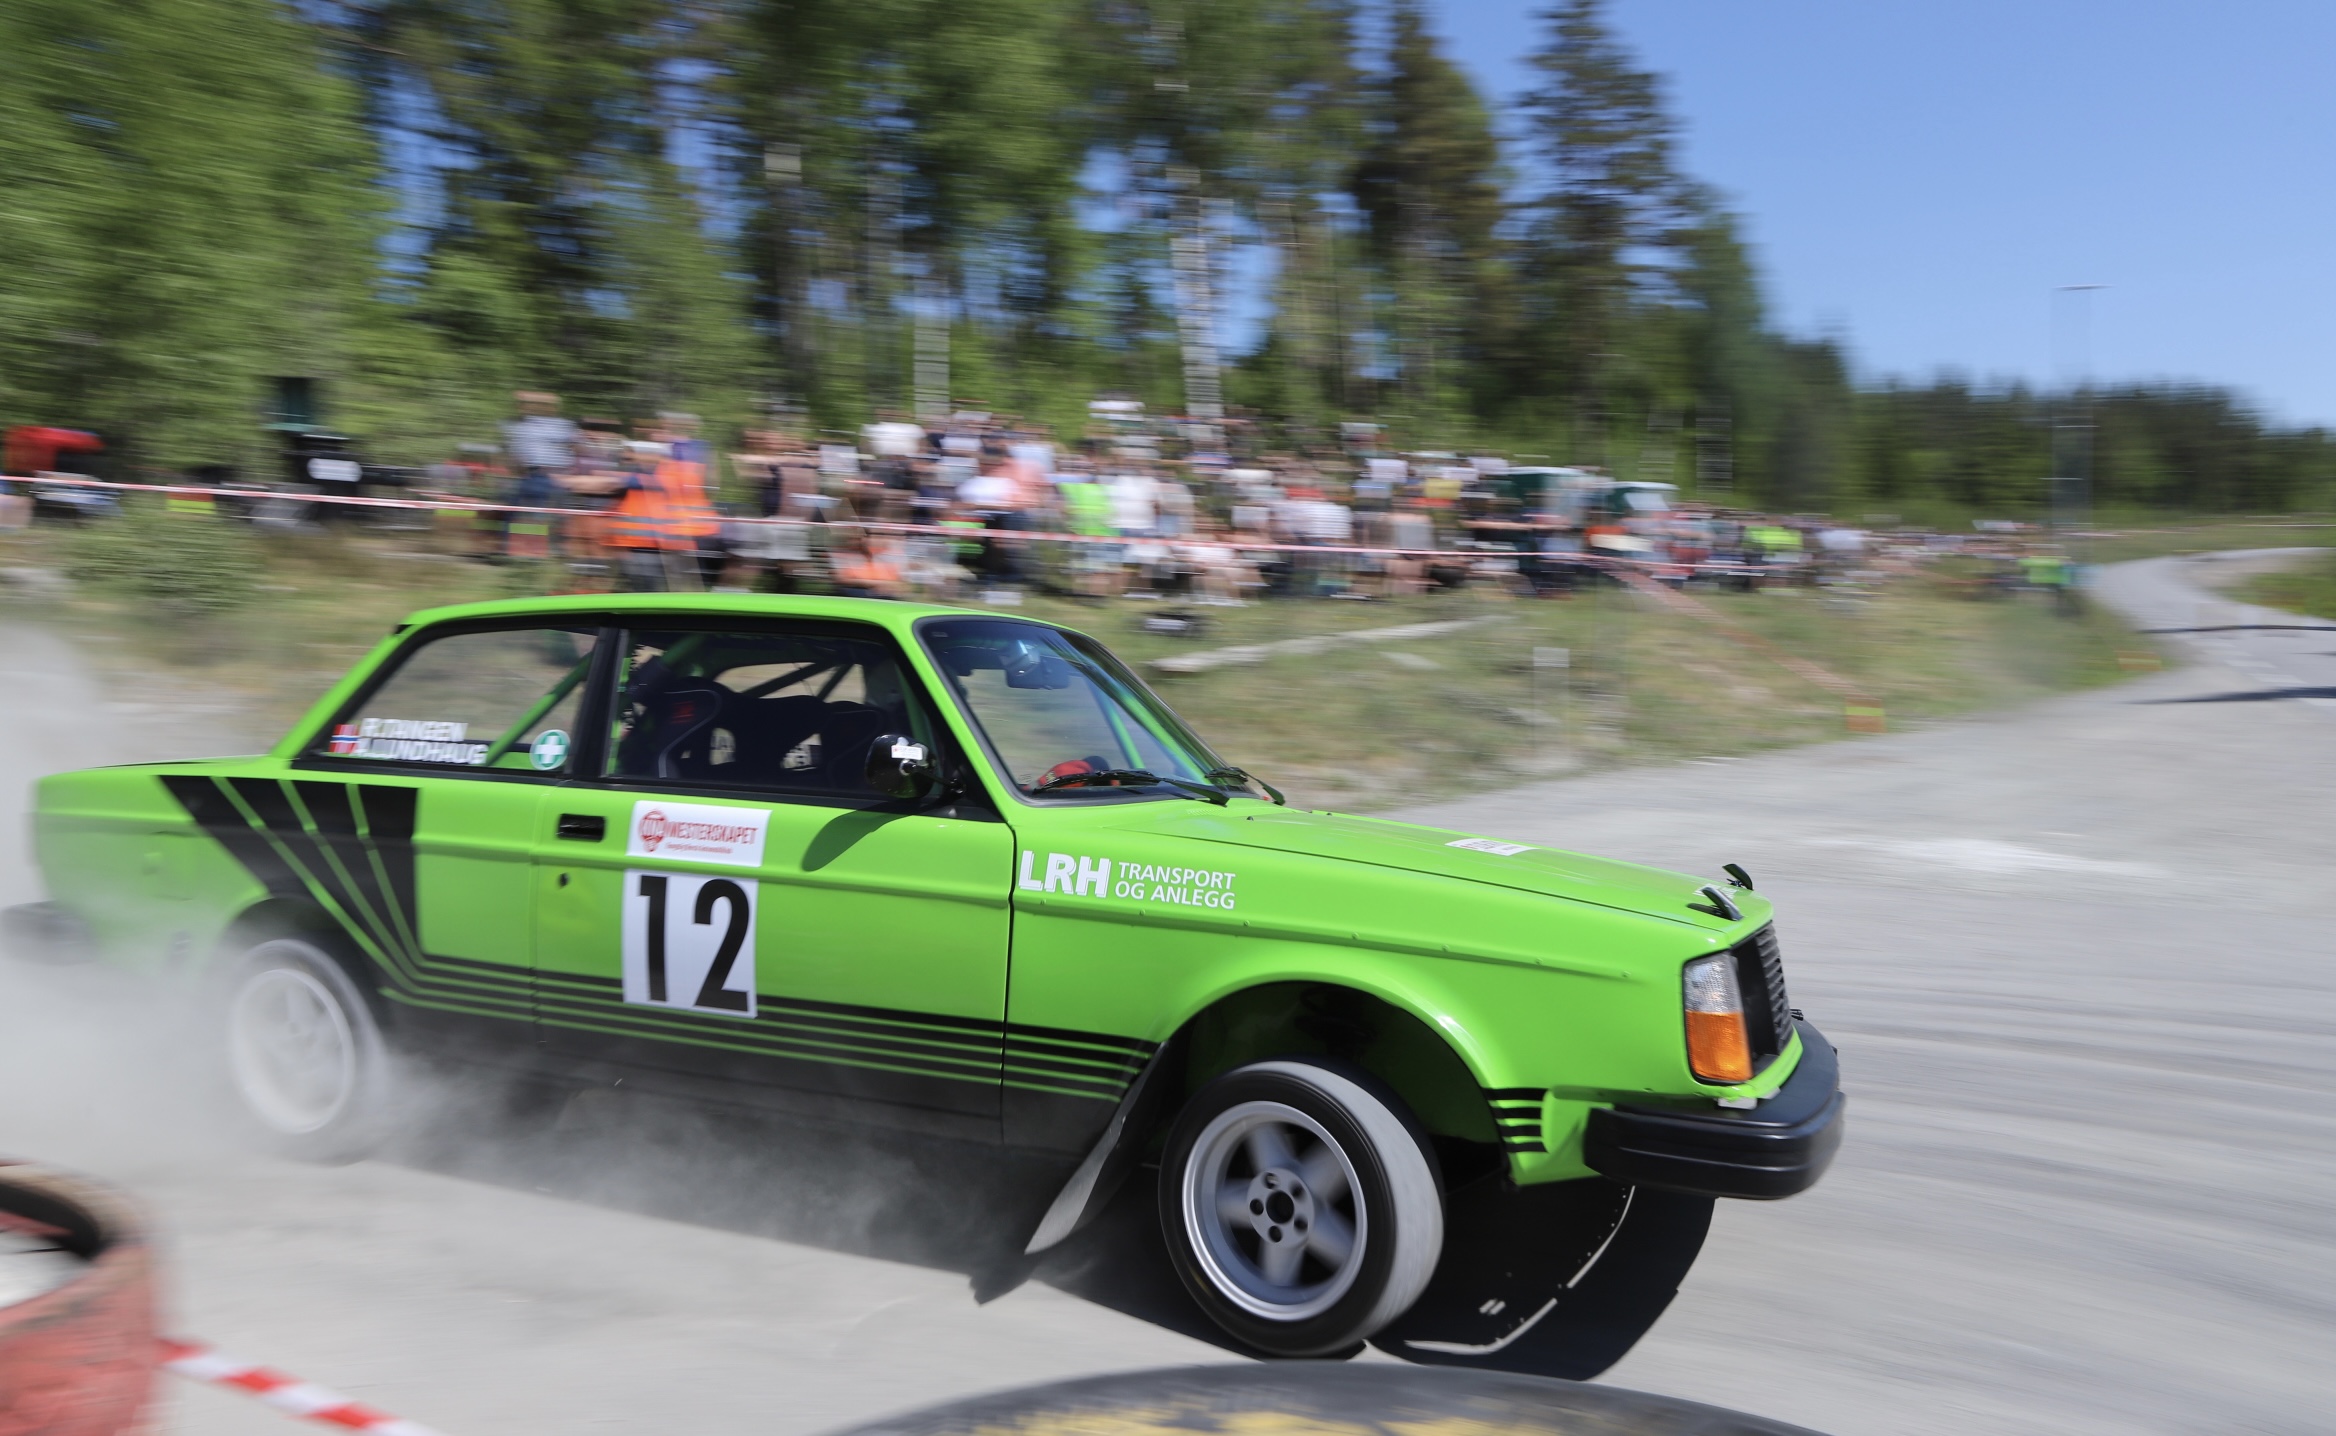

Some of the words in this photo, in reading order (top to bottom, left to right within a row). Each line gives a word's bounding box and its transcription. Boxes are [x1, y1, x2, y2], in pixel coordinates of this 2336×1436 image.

[1018, 850, 1112, 898] LRH
[1118, 861, 1236, 890] TRANSPORT
[1115, 881, 1145, 900] OG
[1150, 885, 1235, 910] ANLEGG
[638, 874, 750, 1012] 12
